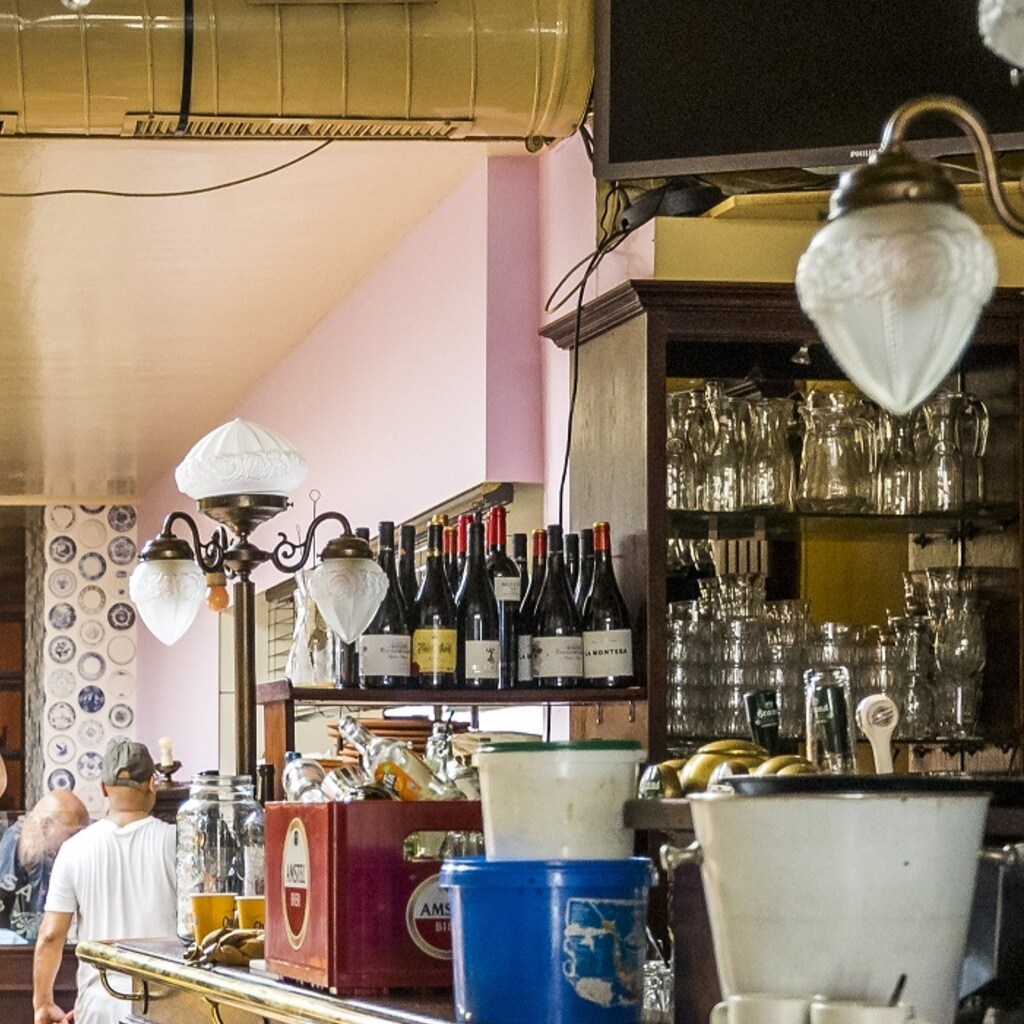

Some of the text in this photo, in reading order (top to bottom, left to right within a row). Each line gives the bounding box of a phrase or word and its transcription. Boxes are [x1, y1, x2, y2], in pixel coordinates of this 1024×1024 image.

[850, 149, 877, 158] PHILI
[592, 648, 628, 656] MONTESA
[285, 863, 306, 884] AMSTEL
[420, 902, 452, 917] AMS
